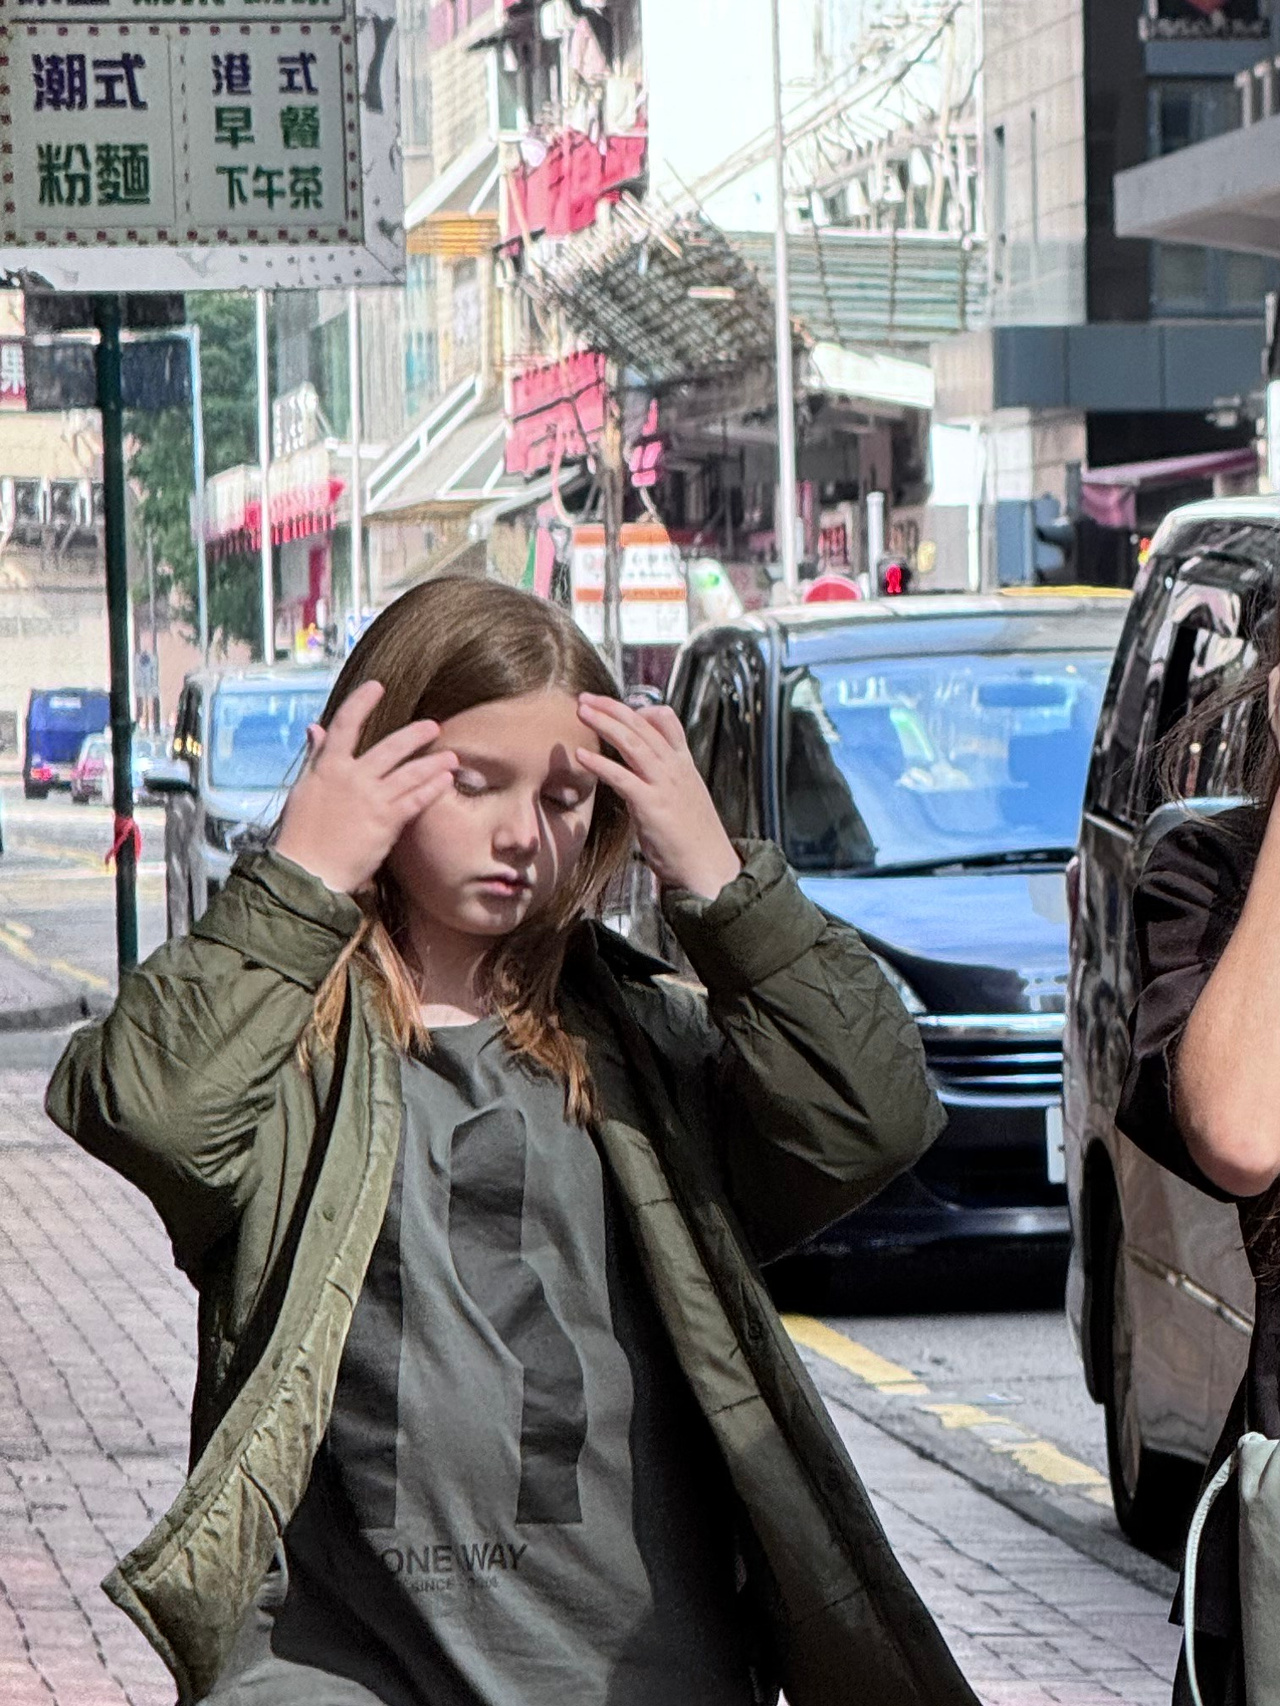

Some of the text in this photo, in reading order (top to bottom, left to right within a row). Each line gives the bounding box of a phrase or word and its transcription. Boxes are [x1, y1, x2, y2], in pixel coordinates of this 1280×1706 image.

[32, 53, 148, 111] 潮式
[211, 52, 319, 95] 港式
[214, 105, 322, 149] 早餐
[37, 143, 150, 206] 粉麵
[215, 164, 323, 210] 下午茶
[381, 1543, 528, 1575] ONE WAY
